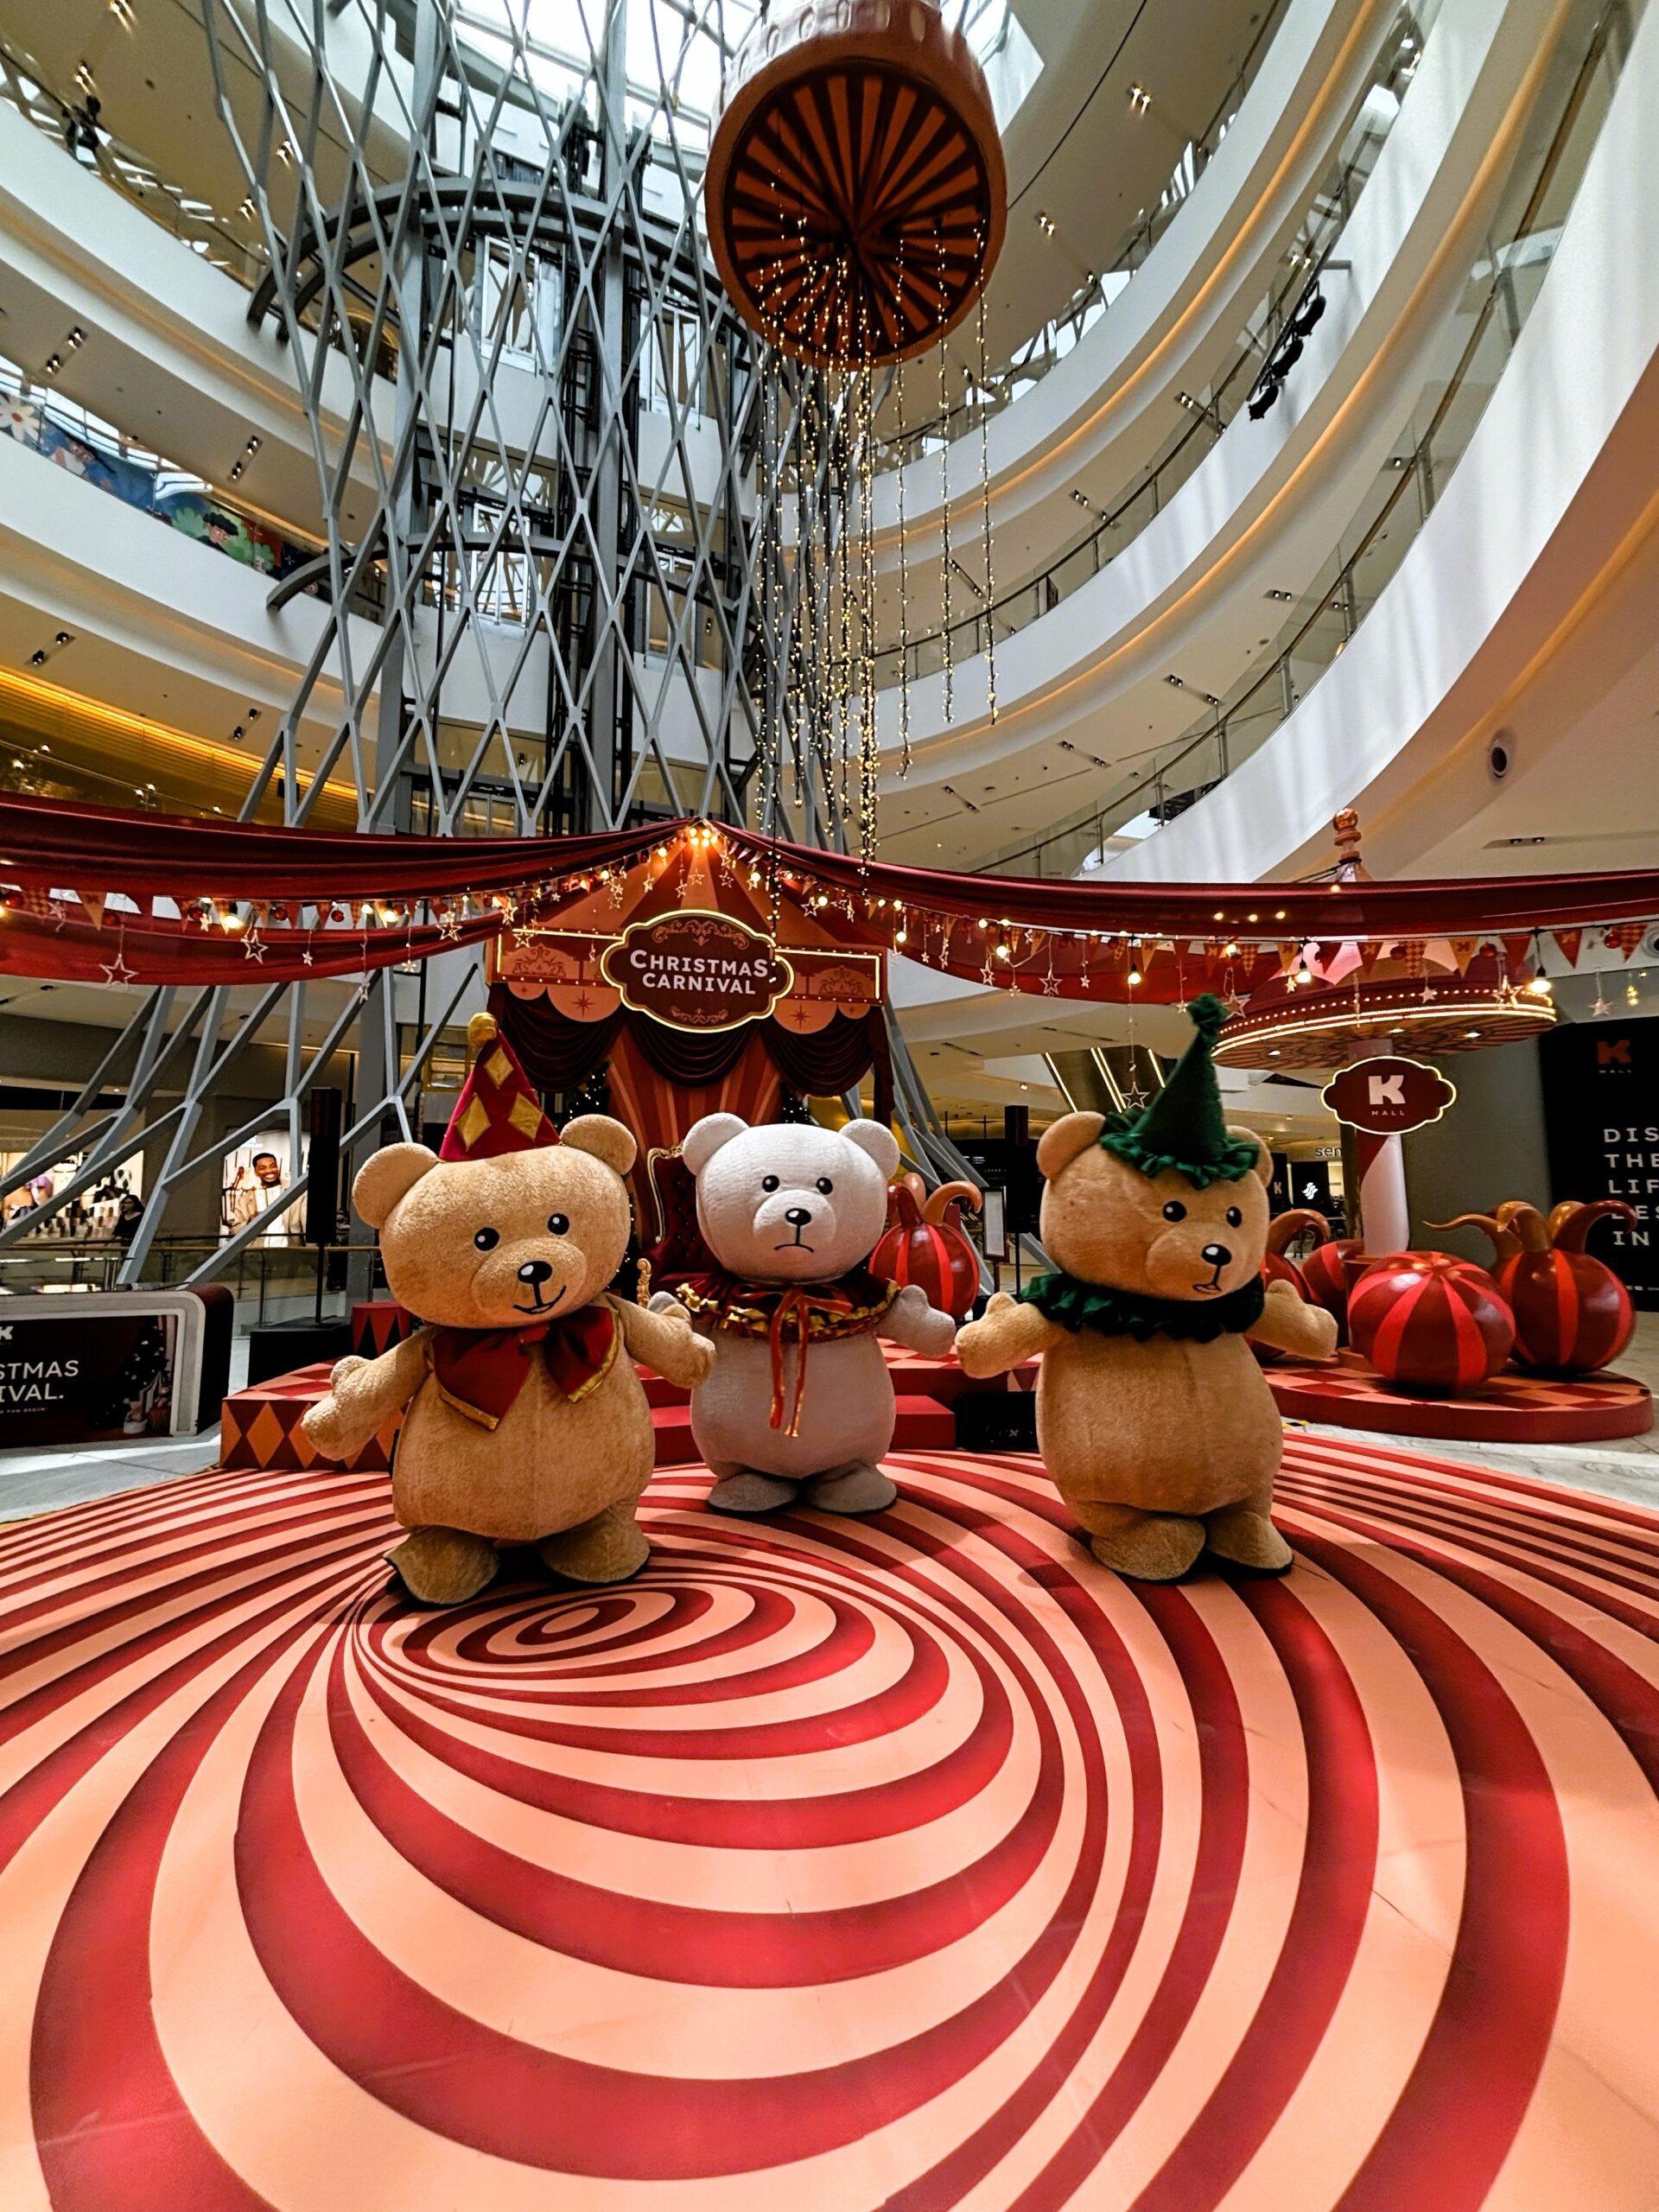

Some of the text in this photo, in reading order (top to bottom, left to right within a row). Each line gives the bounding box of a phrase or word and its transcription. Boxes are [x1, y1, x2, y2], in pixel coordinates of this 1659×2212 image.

[630, 950, 768, 977] CHRISTMAS
[642, 973, 756, 995] CARNIVAL
[1597, 1039, 1631, 1065] K
[1368, 1075, 1406, 1104] K
[1604, 1127, 1659, 1143] DIS
[1605, 1154, 1659, 1168] THE
[1608, 1179, 1659, 1194] LIF
[1612, 1230, 1649, 1246] IN
